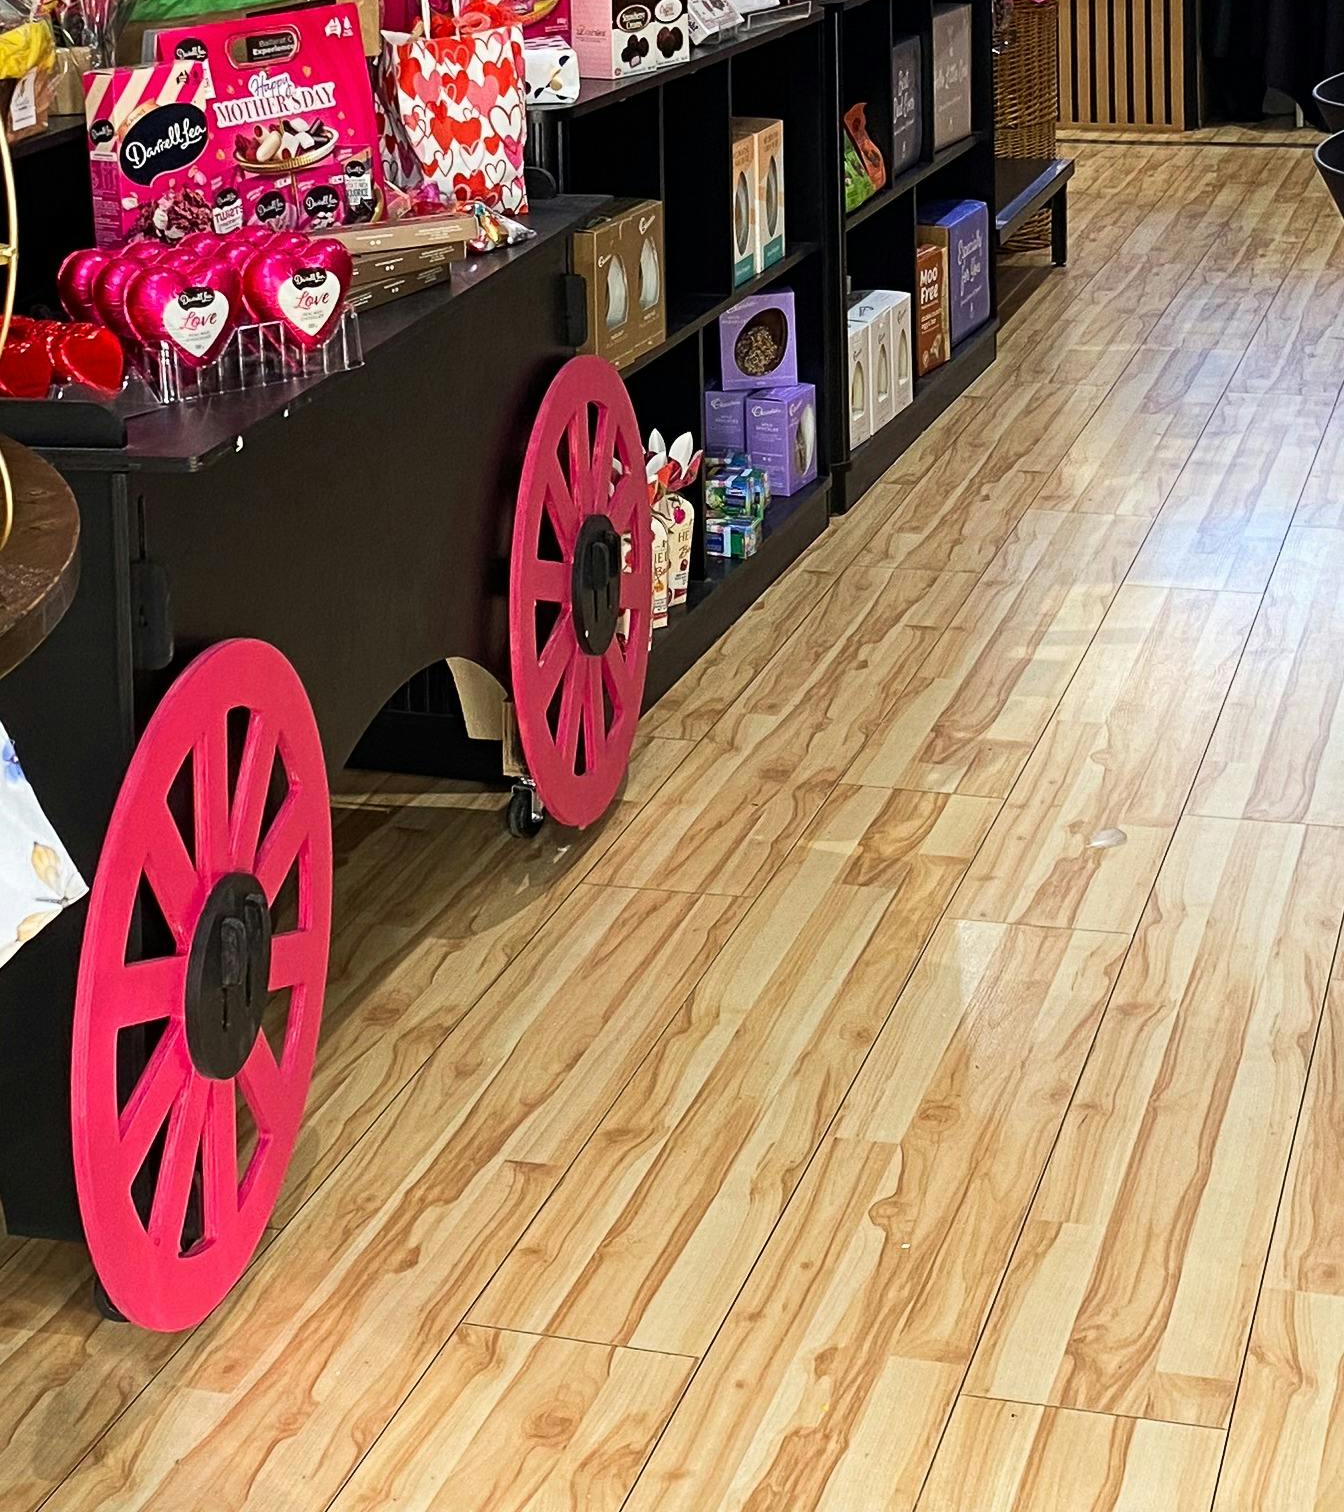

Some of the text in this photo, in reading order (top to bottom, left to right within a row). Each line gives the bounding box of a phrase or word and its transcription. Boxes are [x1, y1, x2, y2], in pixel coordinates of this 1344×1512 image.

[250, 74, 290, 98] Happy
[216, 85, 335, 124] MOTHER'S DAY
[125, 117, 208, 170] Darrell Lea
[293, 291, 330, 311] Love
[178, 311, 219, 332] Love
